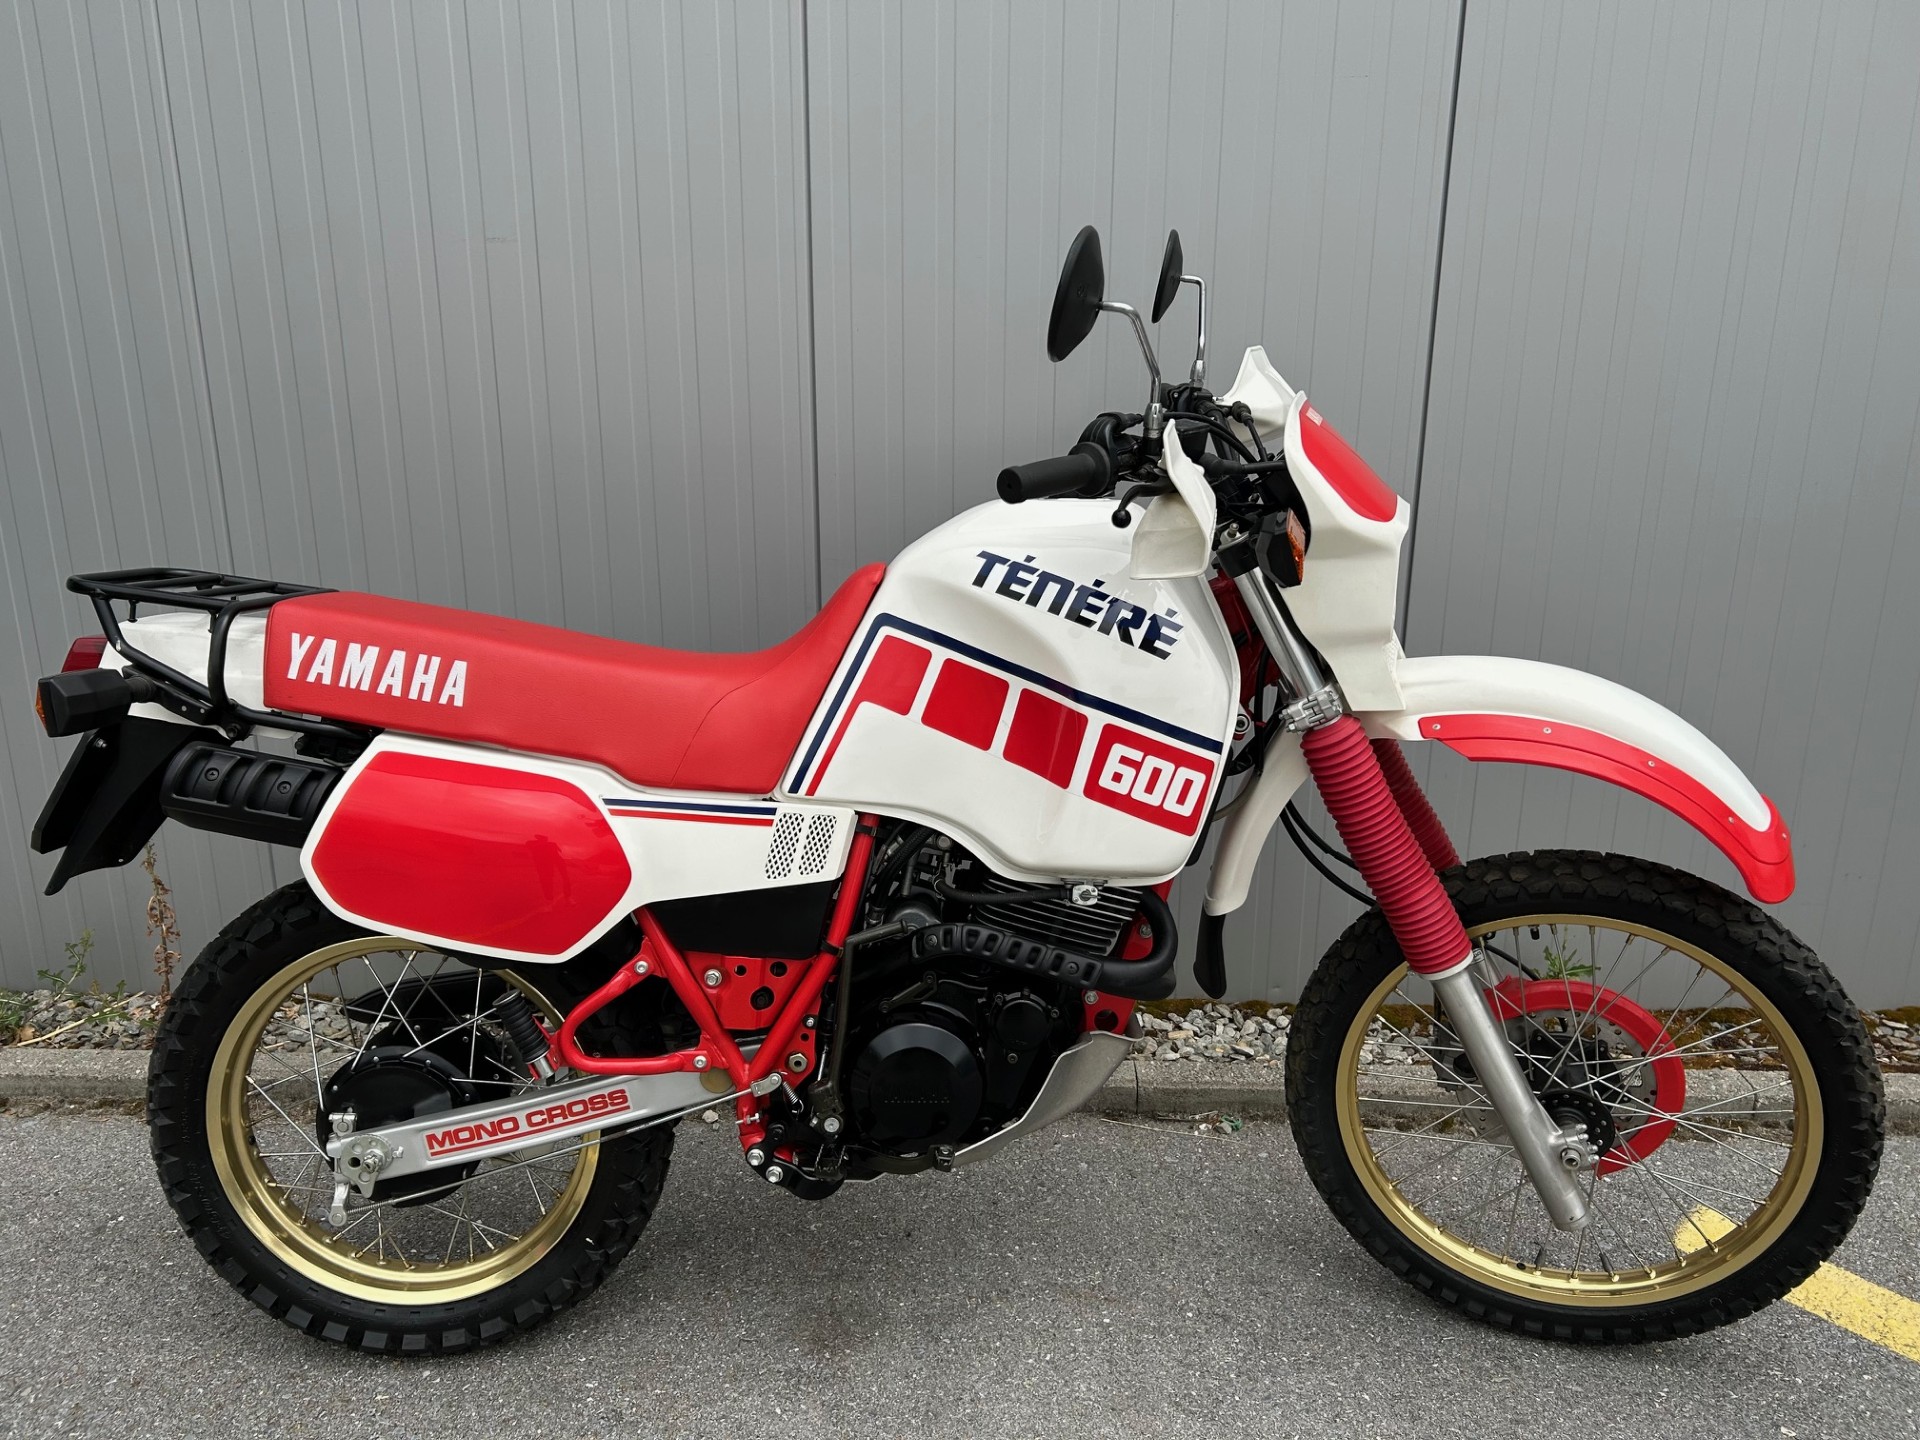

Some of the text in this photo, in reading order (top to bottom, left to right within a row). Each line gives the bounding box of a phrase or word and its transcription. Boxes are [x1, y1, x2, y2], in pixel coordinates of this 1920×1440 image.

[971, 550, 1184, 660] TÉNÉRÉ
[287, 632, 468, 707] YAMAHA
[1098, 743, 1206, 818] 600
[425, 1088, 629, 1150] MONO CROSS
